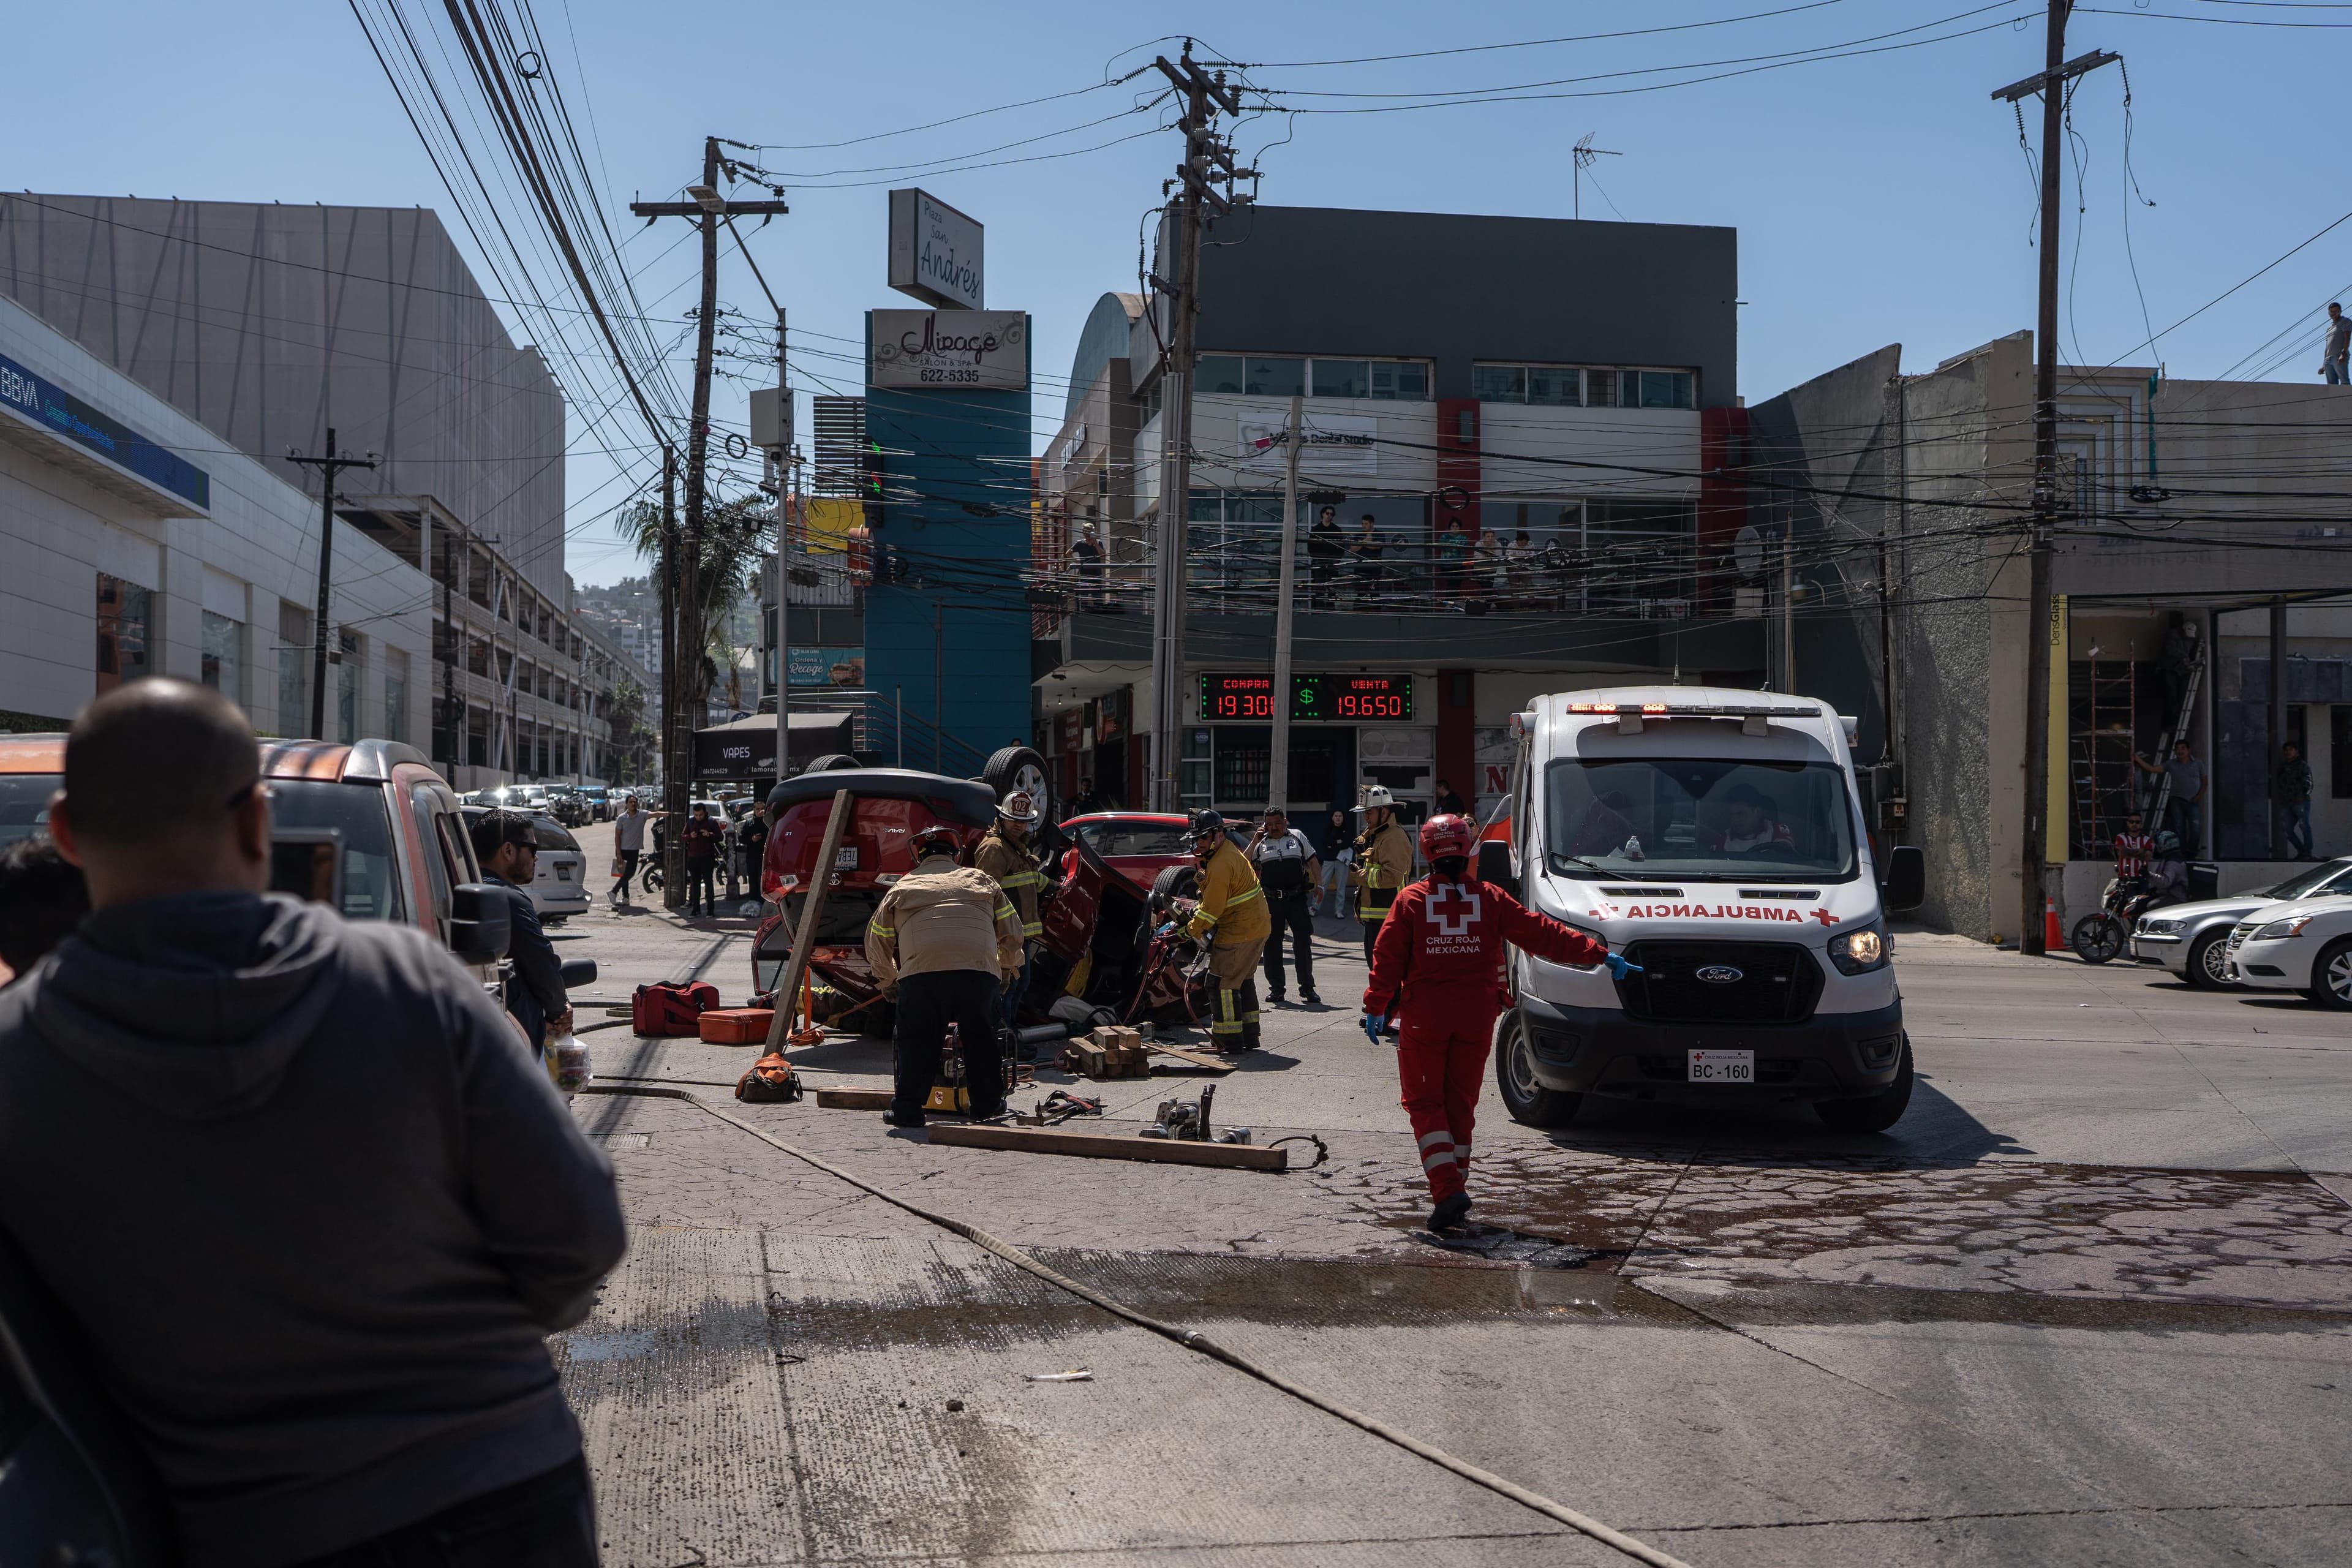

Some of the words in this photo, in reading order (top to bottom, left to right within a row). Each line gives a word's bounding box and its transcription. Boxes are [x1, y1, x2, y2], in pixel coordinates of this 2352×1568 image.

[925, 200, 942, 224] Plaza
[930, 225, 949, 244] San
[921, 240, 980, 300] Andrés
[901, 312, 999, 364] Mirage
[921, 369, 979, 382] 622-5335
[1, 367, 39, 410] BBVA
[1311, 431, 1342, 444] Dental
[1343, 434, 1374, 445] Studio
[2050, 593, 2060, 646] DensGlass
[789, 662, 824, 676] Recoge
[1223, 679, 1270, 690] COMPRA
[1351, 679, 1389, 690] VENTA
[1299, 688, 1314, 705] $
[1338, 696, 1401, 715] 19.650
[722, 747, 750, 759] VAPES
[1485, 765, 1509, 794] N
[1012, 799, 1022, 809] 02
[1426, 945, 1481, 954] MEXICANA
[1693, 1065, 1713, 1078] BC
[1724, 1065, 1749, 1079] 160
